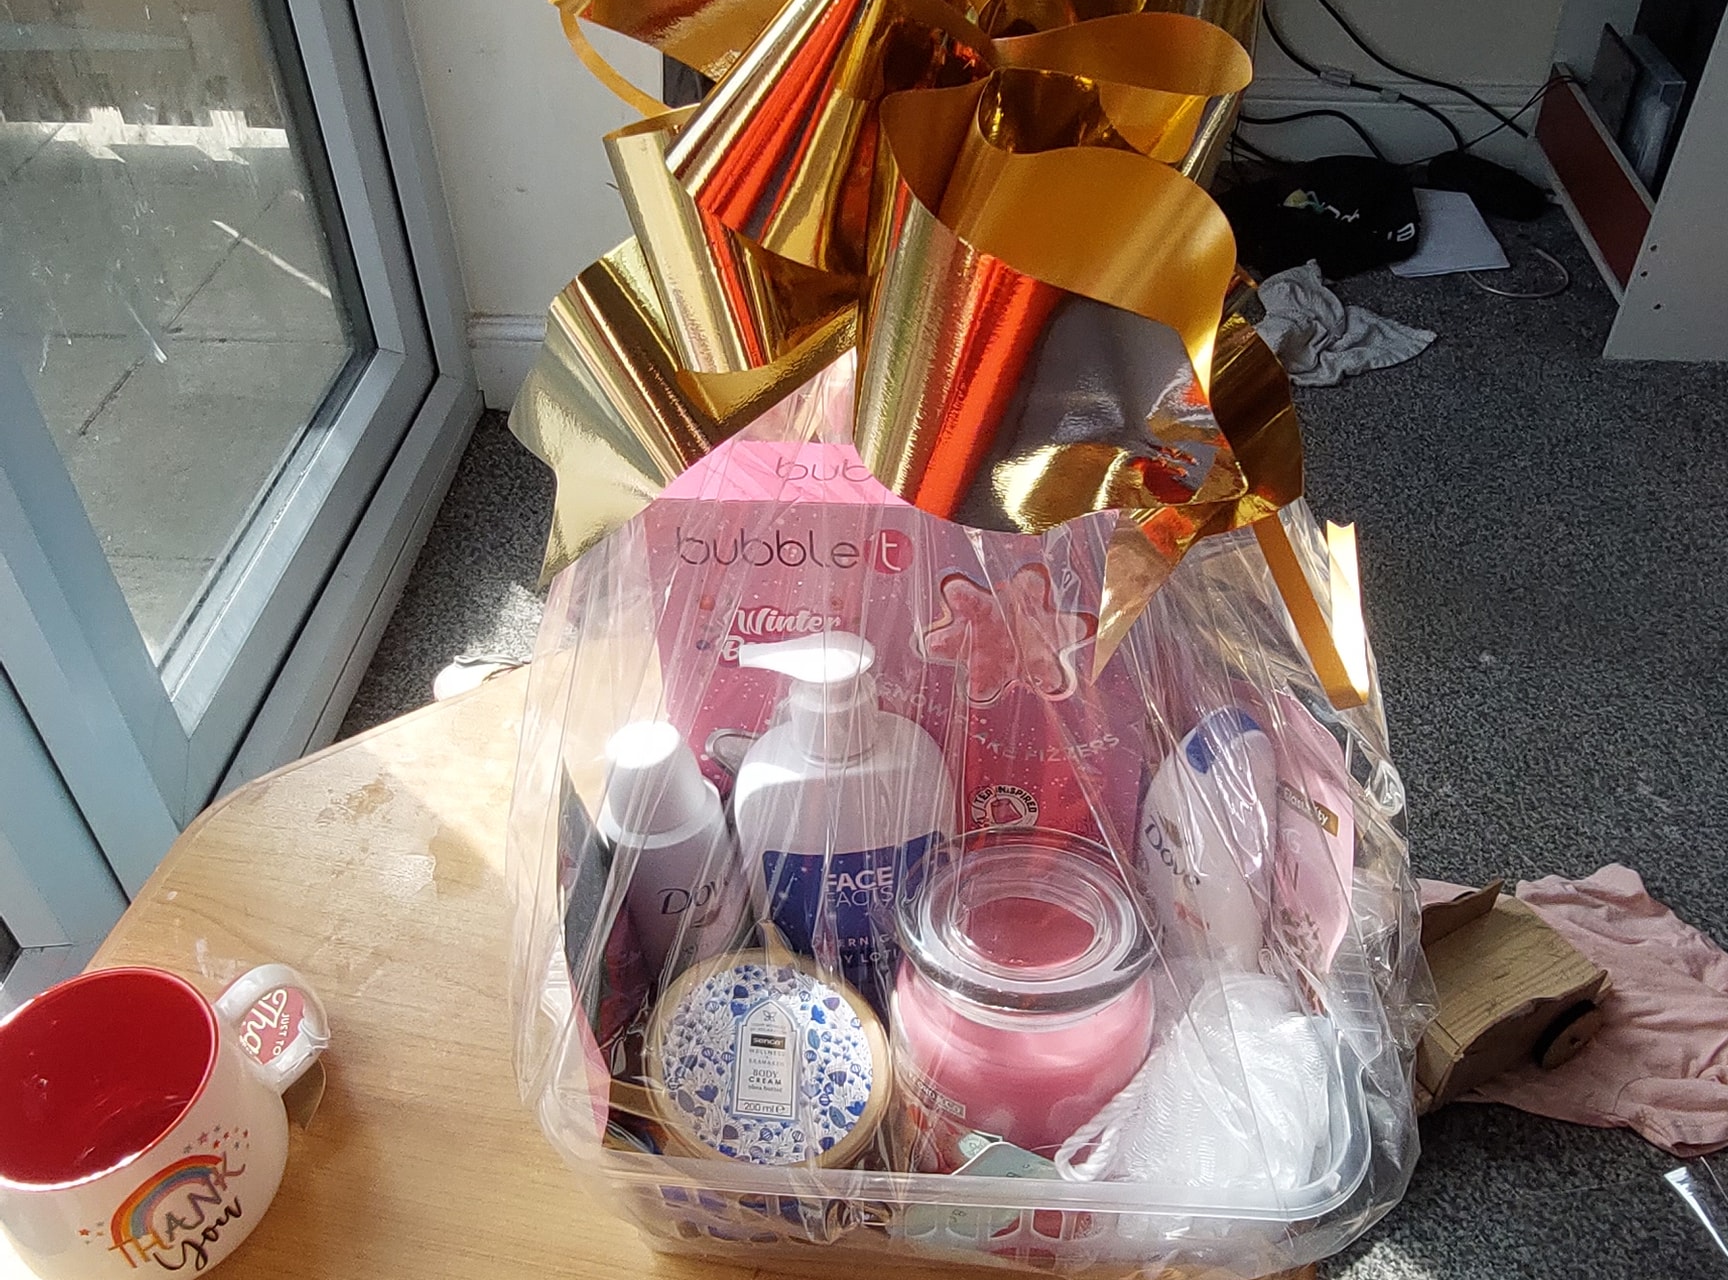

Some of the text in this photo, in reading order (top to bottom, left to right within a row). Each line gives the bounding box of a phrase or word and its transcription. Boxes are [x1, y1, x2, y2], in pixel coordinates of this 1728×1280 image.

[776, 457, 872, 483] bub
[725, 605, 842, 636] Winter
[974, 787, 994, 804] TEA
[826, 866, 894, 893] FACE
[244, 988, 288, 1055] Tha
[272, 1012, 291, 1057] JUST TO
[748, 1076, 782, 1086] CREAM
[752, 1069, 779, 1078] BODY
[743, 1102, 761, 1112] 200
[762, 1104, 775, 1113] ml
[108, 1151, 246, 1269] THANK
